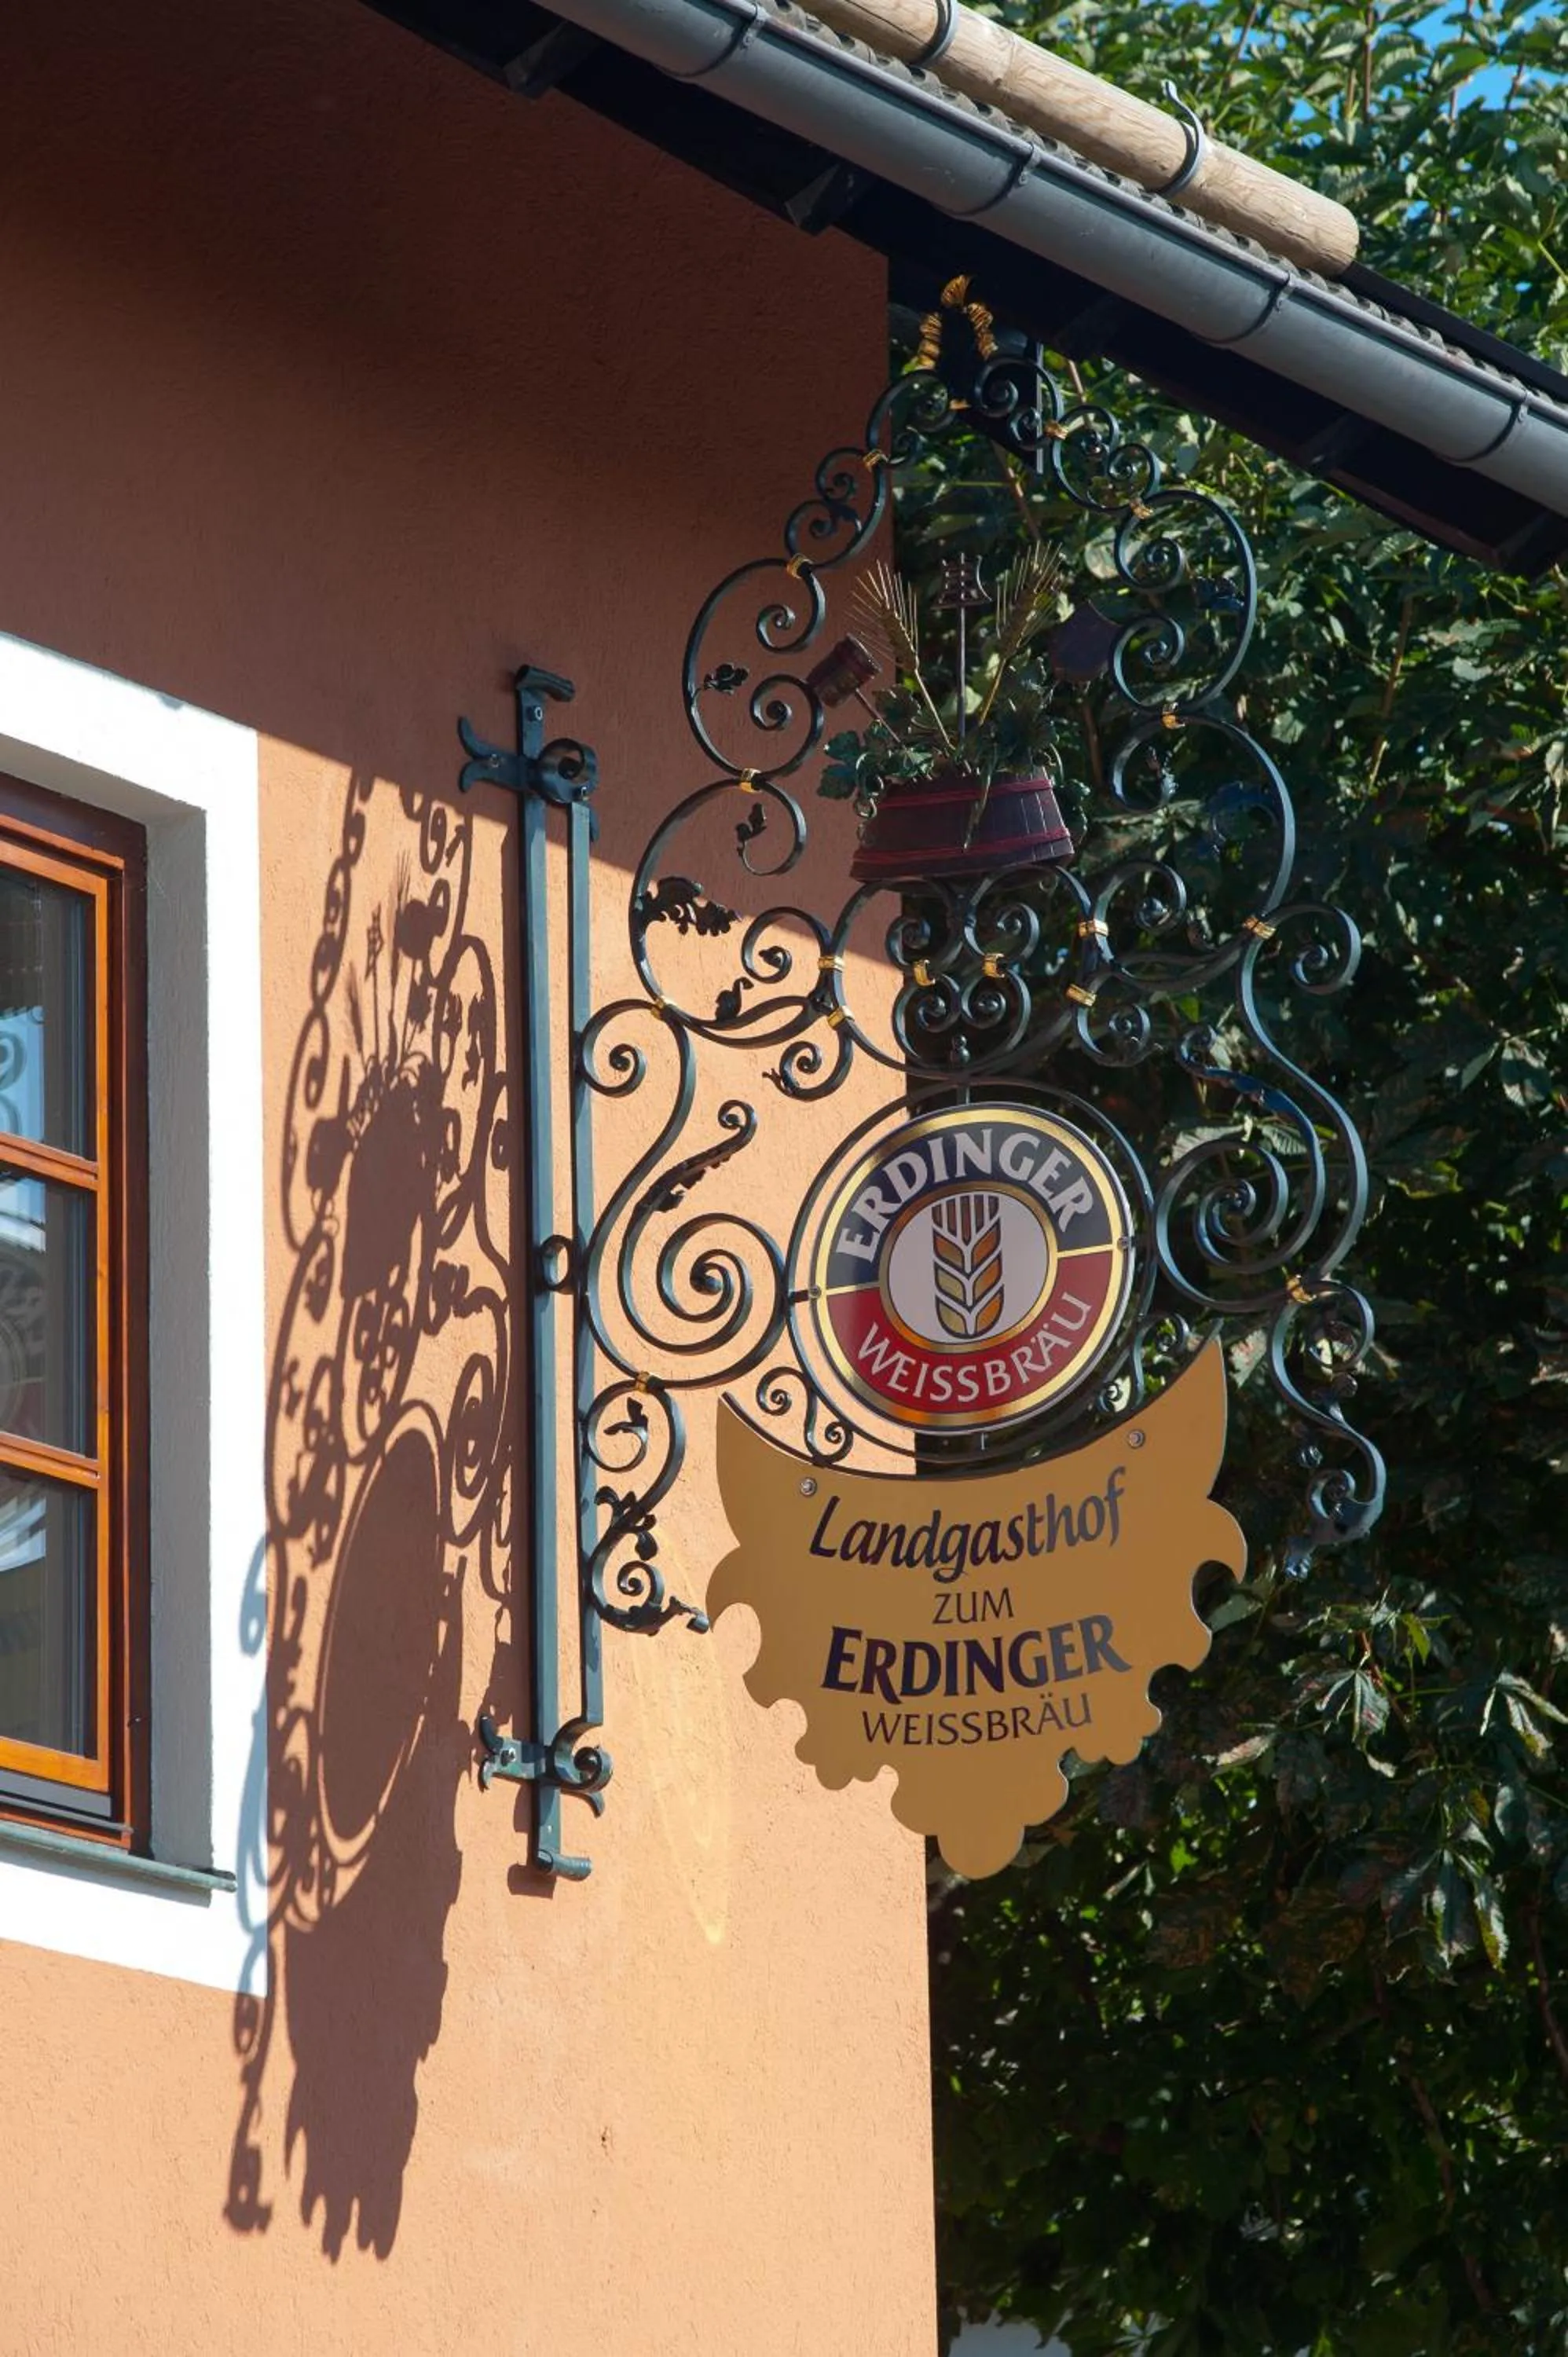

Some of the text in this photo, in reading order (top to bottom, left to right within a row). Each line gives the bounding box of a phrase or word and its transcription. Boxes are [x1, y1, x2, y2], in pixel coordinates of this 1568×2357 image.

[837, 1128, 1093, 1263] ERDINGER
[858, 1292, 1091, 1402] WEISSBRÄU
[810, 1467, 1125, 1582] Landgasthof
[933, 1588, 1013, 1624] ZUM
[822, 1615, 1132, 1704] ERDINGER
[863, 1693, 1091, 1745] WEISSBRÄU
